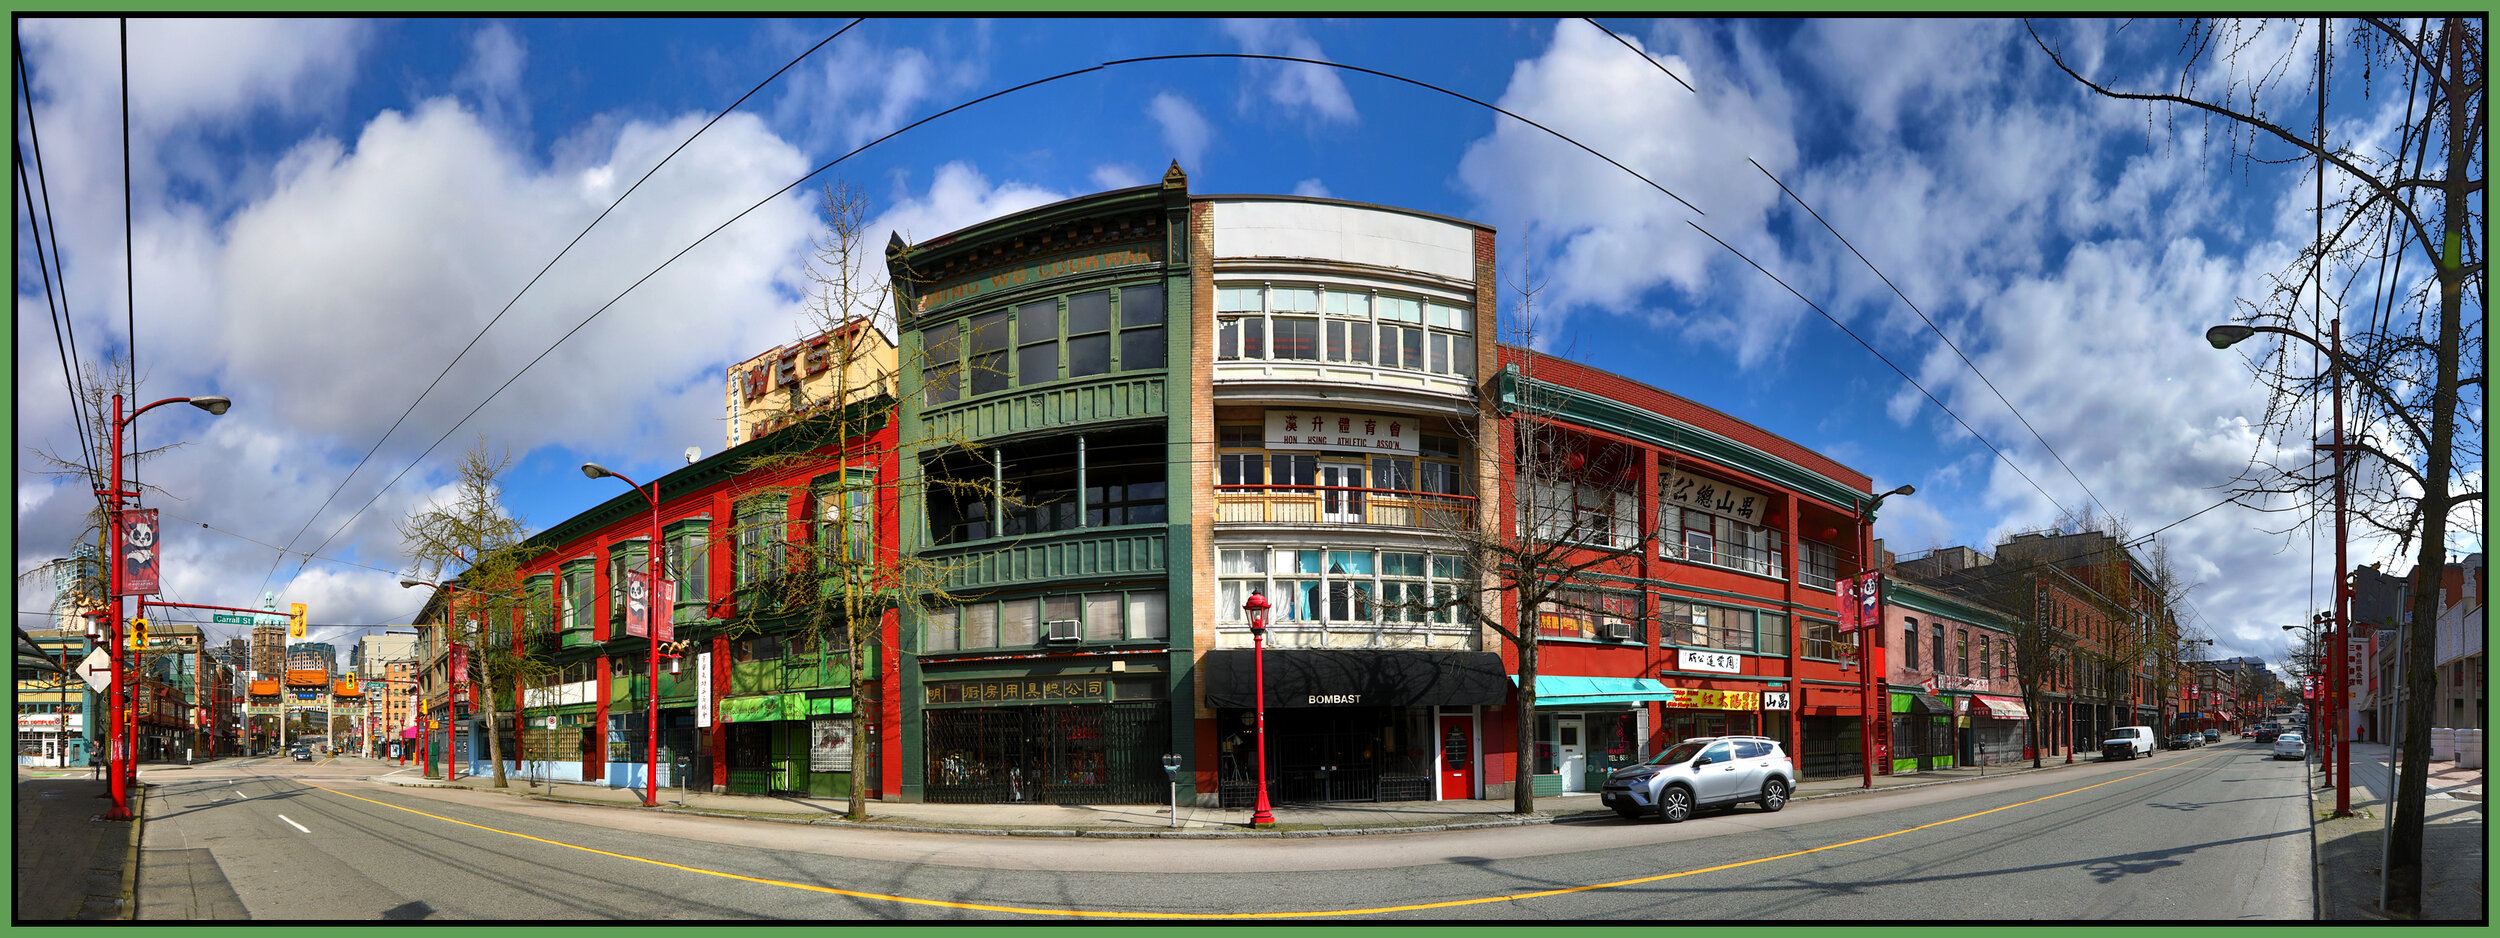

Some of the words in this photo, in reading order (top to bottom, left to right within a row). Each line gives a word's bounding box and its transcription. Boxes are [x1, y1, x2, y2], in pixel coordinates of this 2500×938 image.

[926, 281, 980, 306] MING
[990, 264, 1027, 289] WO
[1037, 243, 1163, 279] COOKWARE
[741, 324, 861, 400] WEST
[1283, 435, 1298, 444] HON
[1307, 436, 1327, 445] HSING
[1337, 437, 1367, 447] ATHLETIC
[216, 615, 240, 623] Carrall
[1308, 694, 1361, 704] BOMBAST
